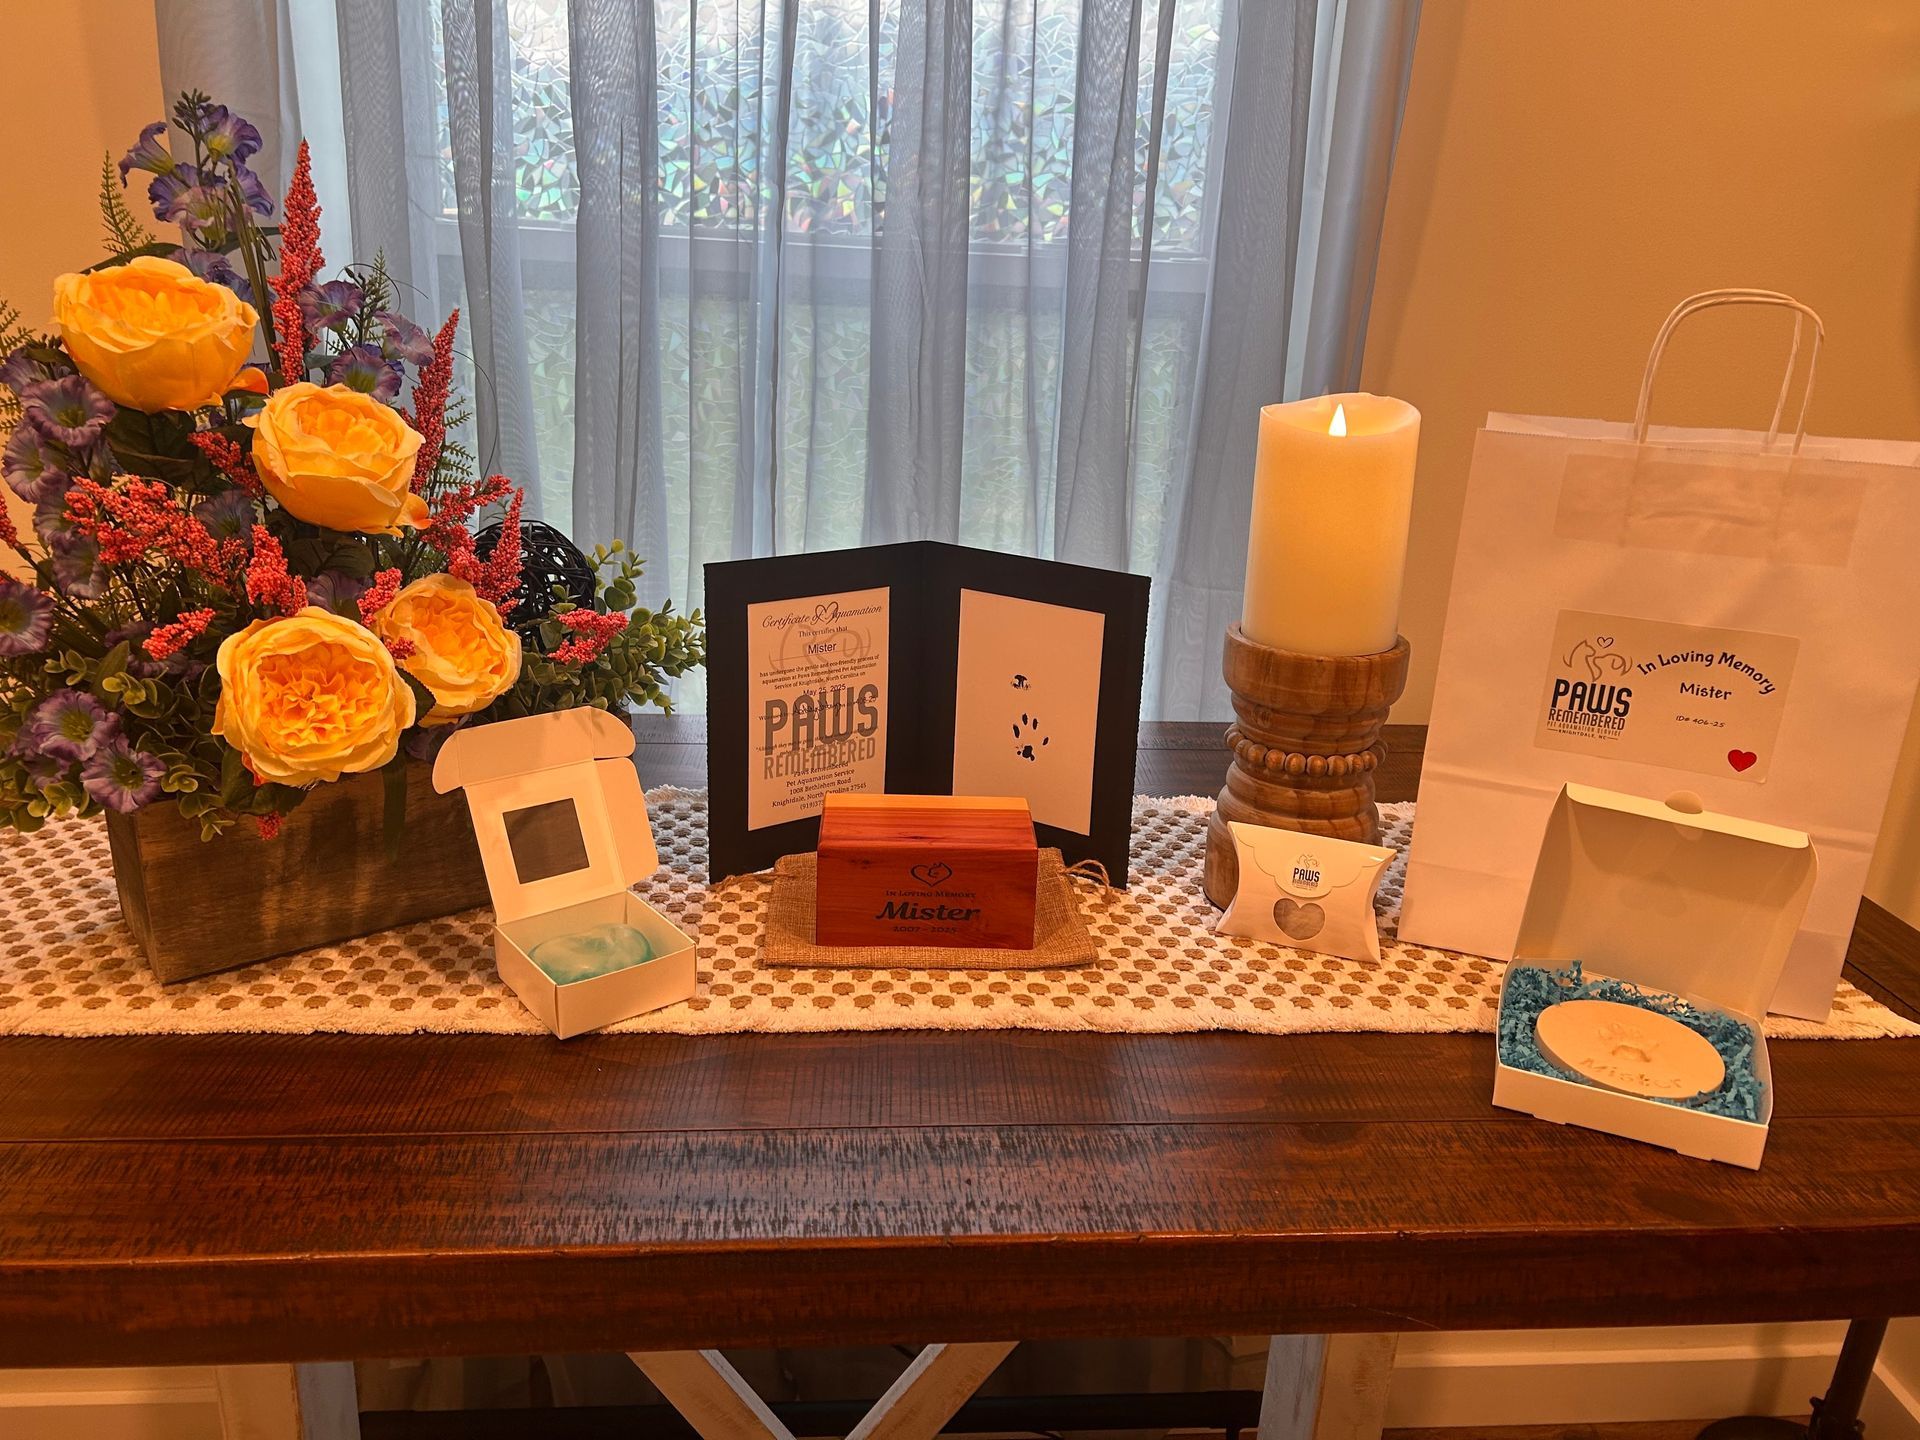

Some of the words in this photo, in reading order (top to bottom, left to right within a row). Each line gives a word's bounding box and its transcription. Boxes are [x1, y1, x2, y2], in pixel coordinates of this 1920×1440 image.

[762, 613, 810, 630] Certificate
[810, 610, 824, 626] of
[799, 630, 812, 638] This
[812, 627, 835, 637] certifies
[808, 643, 837, 655] Mister
[1637, 661, 1657, 676] In
[1657, 650, 1715, 668] Loving
[1717, 651, 1776, 695] Memory
[1551, 678, 1633, 718] PAWS
[1679, 682, 1732, 700] Mister
[764, 684, 879, 757] PAWS
[1548, 708, 1626, 731] REMEMBERED
[1692, 718, 1725, 728] 406-25
[763, 738, 876, 780] REMEMBERED
[786, 780, 797, 788] Pet
[797, 773, 834, 785] Aquamation
[834, 769, 855, 778] Service
[805, 780, 836, 792] Bethlehem
[837, 777, 852, 786] Road
[807, 791, 825, 801] North
[1293, 867, 1320, 883] PAWS
[874, 900, 981, 921] Mister
